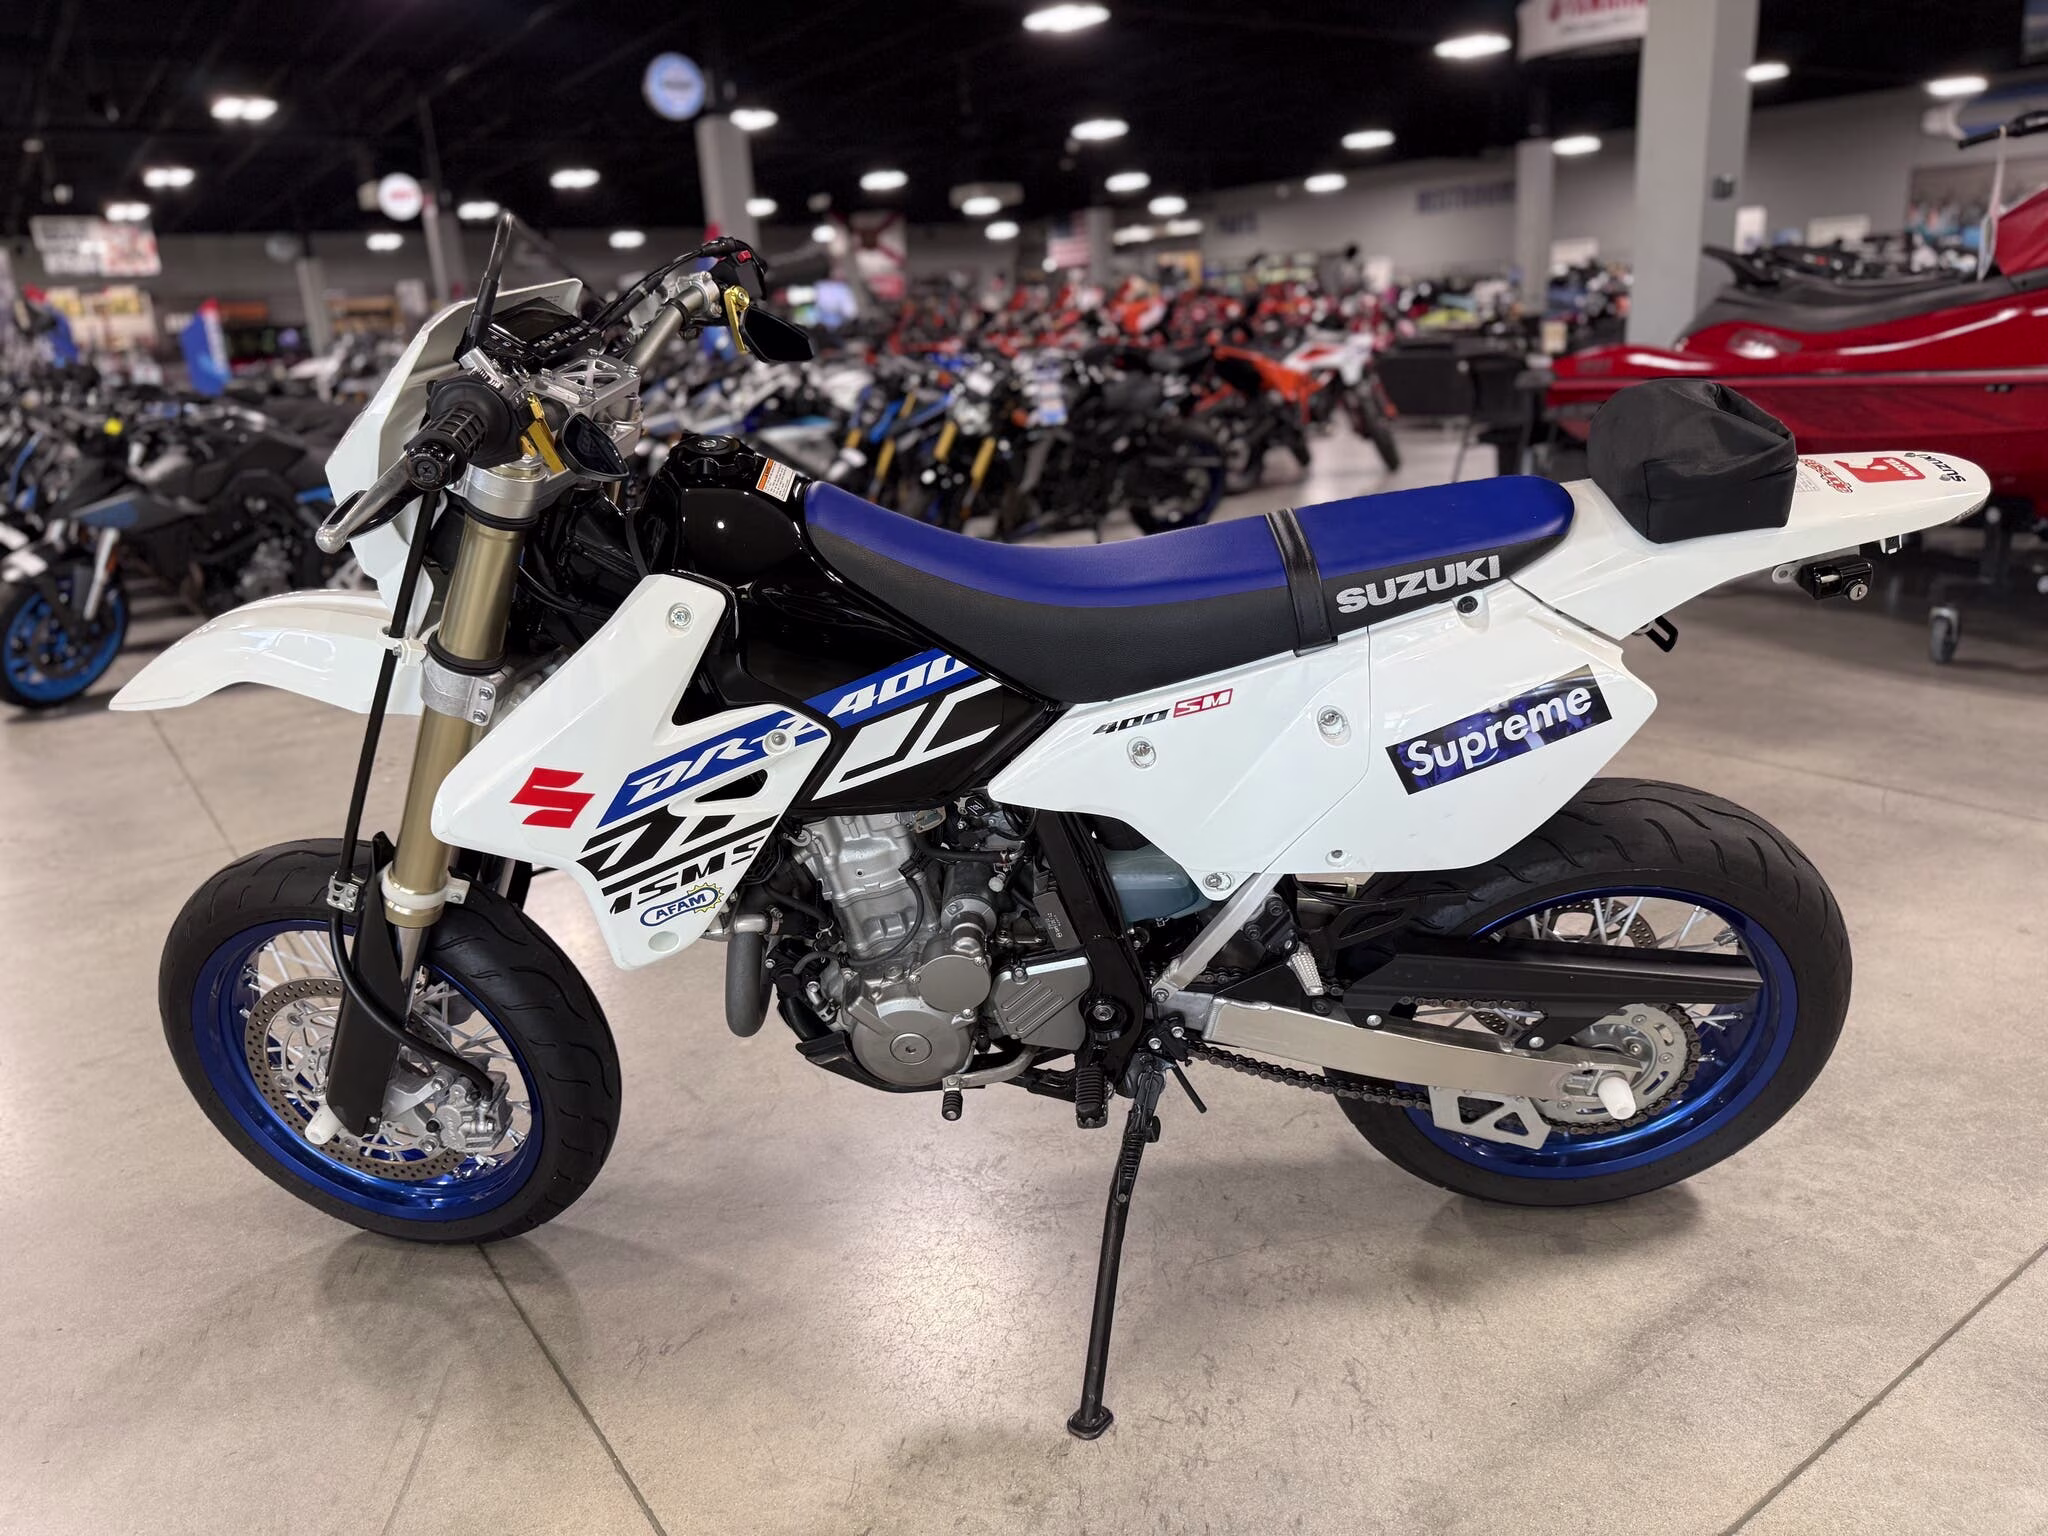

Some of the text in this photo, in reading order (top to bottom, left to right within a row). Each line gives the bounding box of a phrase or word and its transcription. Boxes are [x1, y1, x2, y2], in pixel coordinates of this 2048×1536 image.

[1336, 555, 1501, 614] SUZUKI
[1092, 690, 1231, 735] 400 SM
[1407, 687, 1592, 777] Supreme
[655, 893, 707, 920] AFAM
